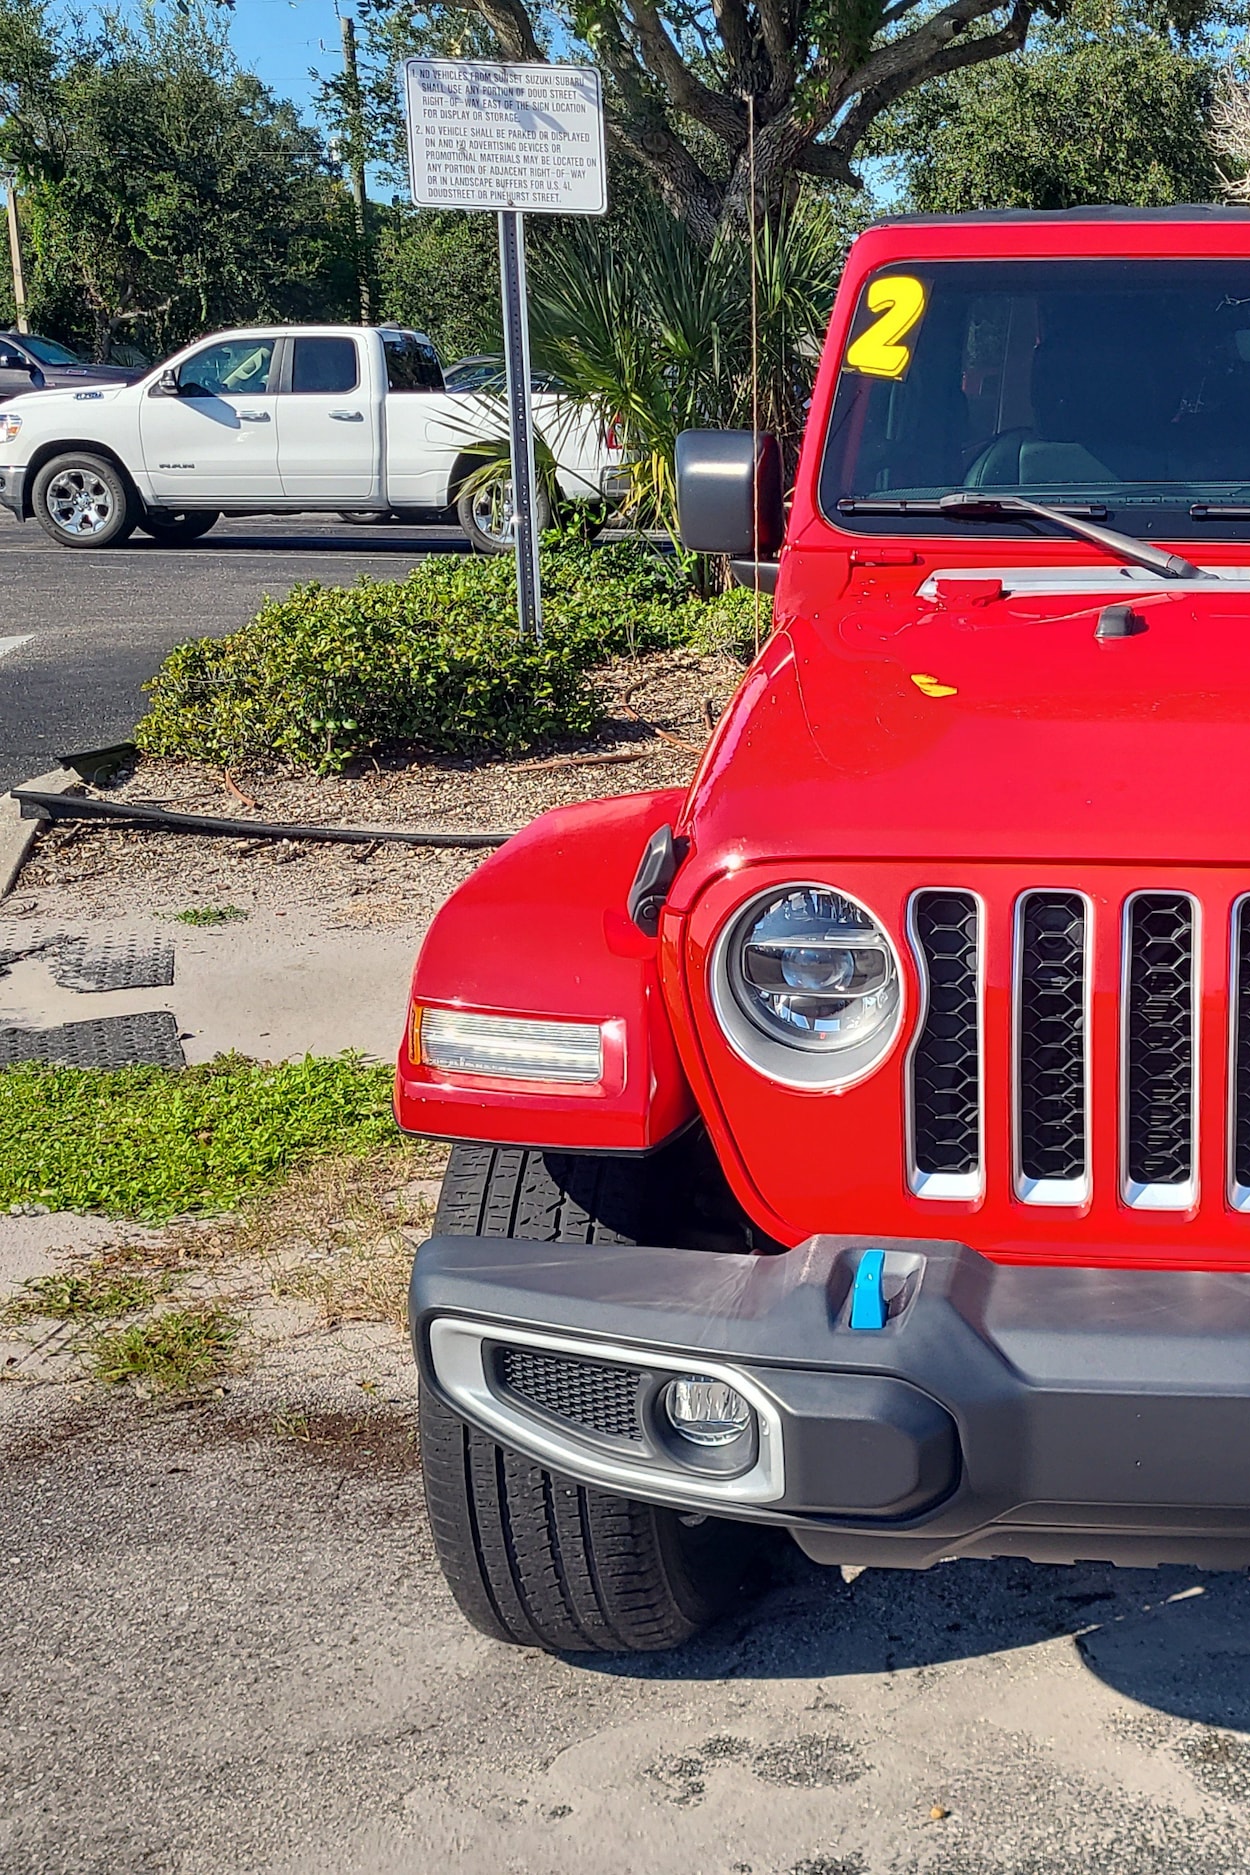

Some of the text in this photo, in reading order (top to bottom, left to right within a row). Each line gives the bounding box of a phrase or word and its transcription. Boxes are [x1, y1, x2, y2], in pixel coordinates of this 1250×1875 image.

[420, 70, 430, 78] NO
[433, 70, 467, 80] VEHICLES
[471, 72, 491, 81] FROM
[494, 73, 522, 84] SUNSET
[422, 83, 576, 100] SHALL USE ANY PORTION OF DOUD STREET
[423, 96, 586, 113] RIGHT-OF-WAY EAST OF THE SIGN LOCATION
[424, 109, 437, 118] FOR
[441, 110, 470, 120] DISPLAY
[416, 125, 589, 142] 2. NO VEHICLE SHALL BE PARKED OR DISPLAYED
[425, 138, 436, 147] ON
[439, 139, 453, 148] AND
[469, 140, 516, 151] ADVERTISING
[520, 143, 549, 152] DEVICES
[552, 144, 561, 153] OR
[426, 151, 596, 167] PROMOTIONAL MATERIALS MAY BE LOCATED ON
[427, 163, 586, 179] ANY PORTION OF ADJACENT RIGHT-OF-WAY
[428, 176, 437, 184] OR
[440, 176, 448, 185] IN
[450, 176, 493, 187] LANDSCAPE
[496, 179, 528, 188] BUFFERS
[531, 180, 544, 189] FOR
[478, 190, 488, 199] OR
[491, 191, 529, 201] PINEHURST
[533, 192, 561, 202] STREET.
[847, 277, 925, 377] 2
